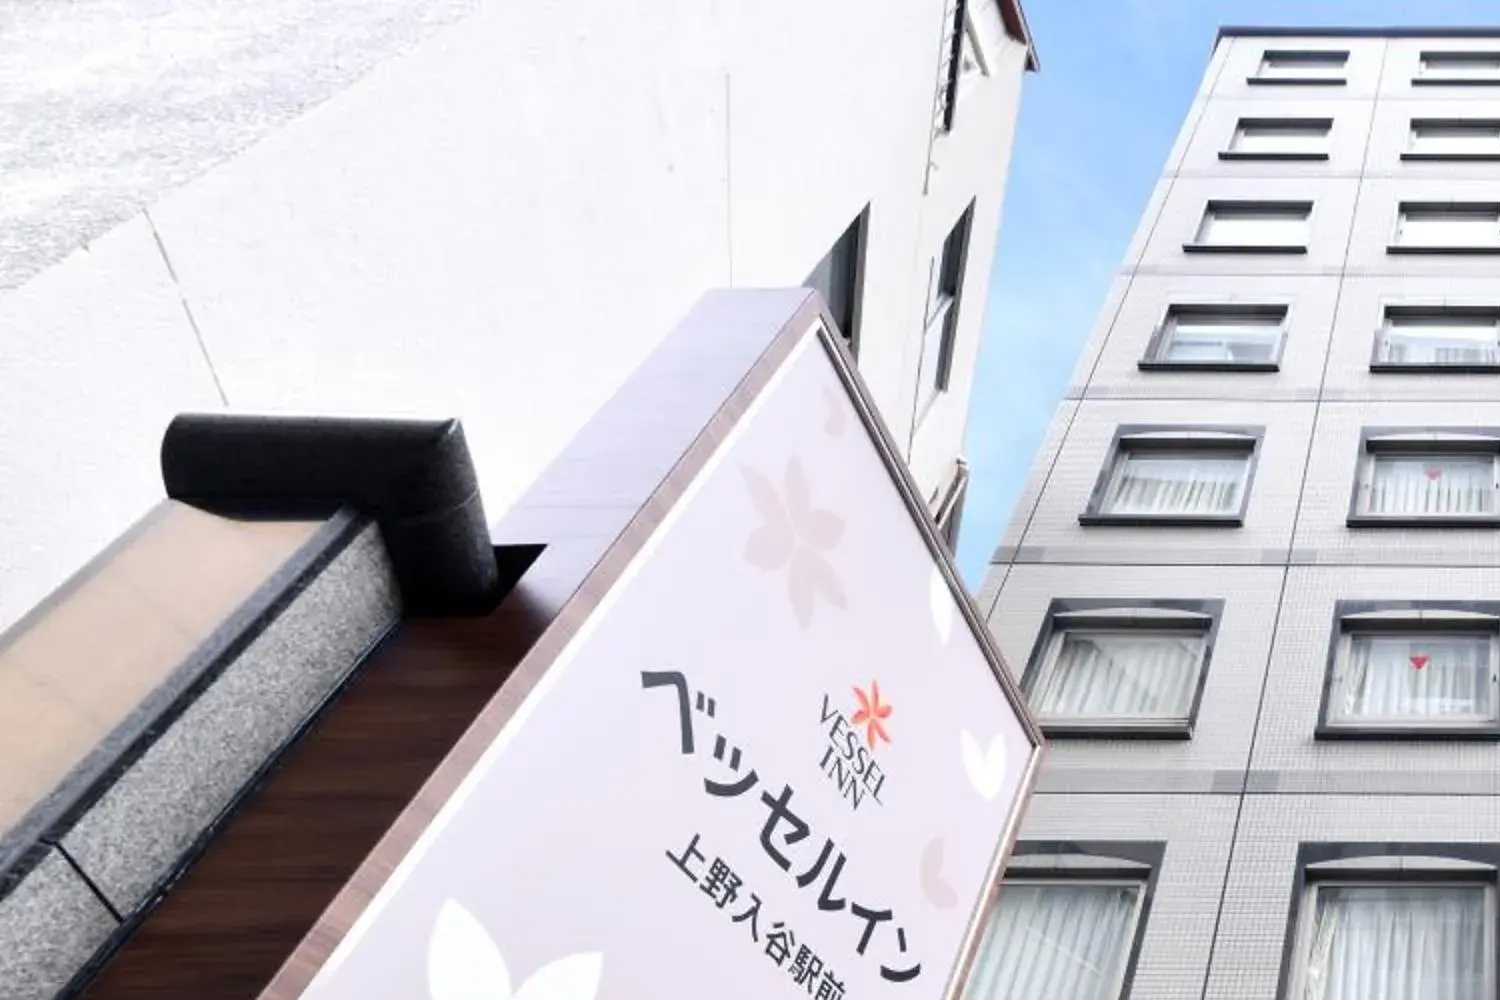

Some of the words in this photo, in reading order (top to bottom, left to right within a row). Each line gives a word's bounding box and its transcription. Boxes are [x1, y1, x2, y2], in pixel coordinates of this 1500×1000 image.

[819, 747, 864, 811] INN
[820, 694, 886, 806] VESSEL
[641, 671, 921, 982] ベッセルイン
